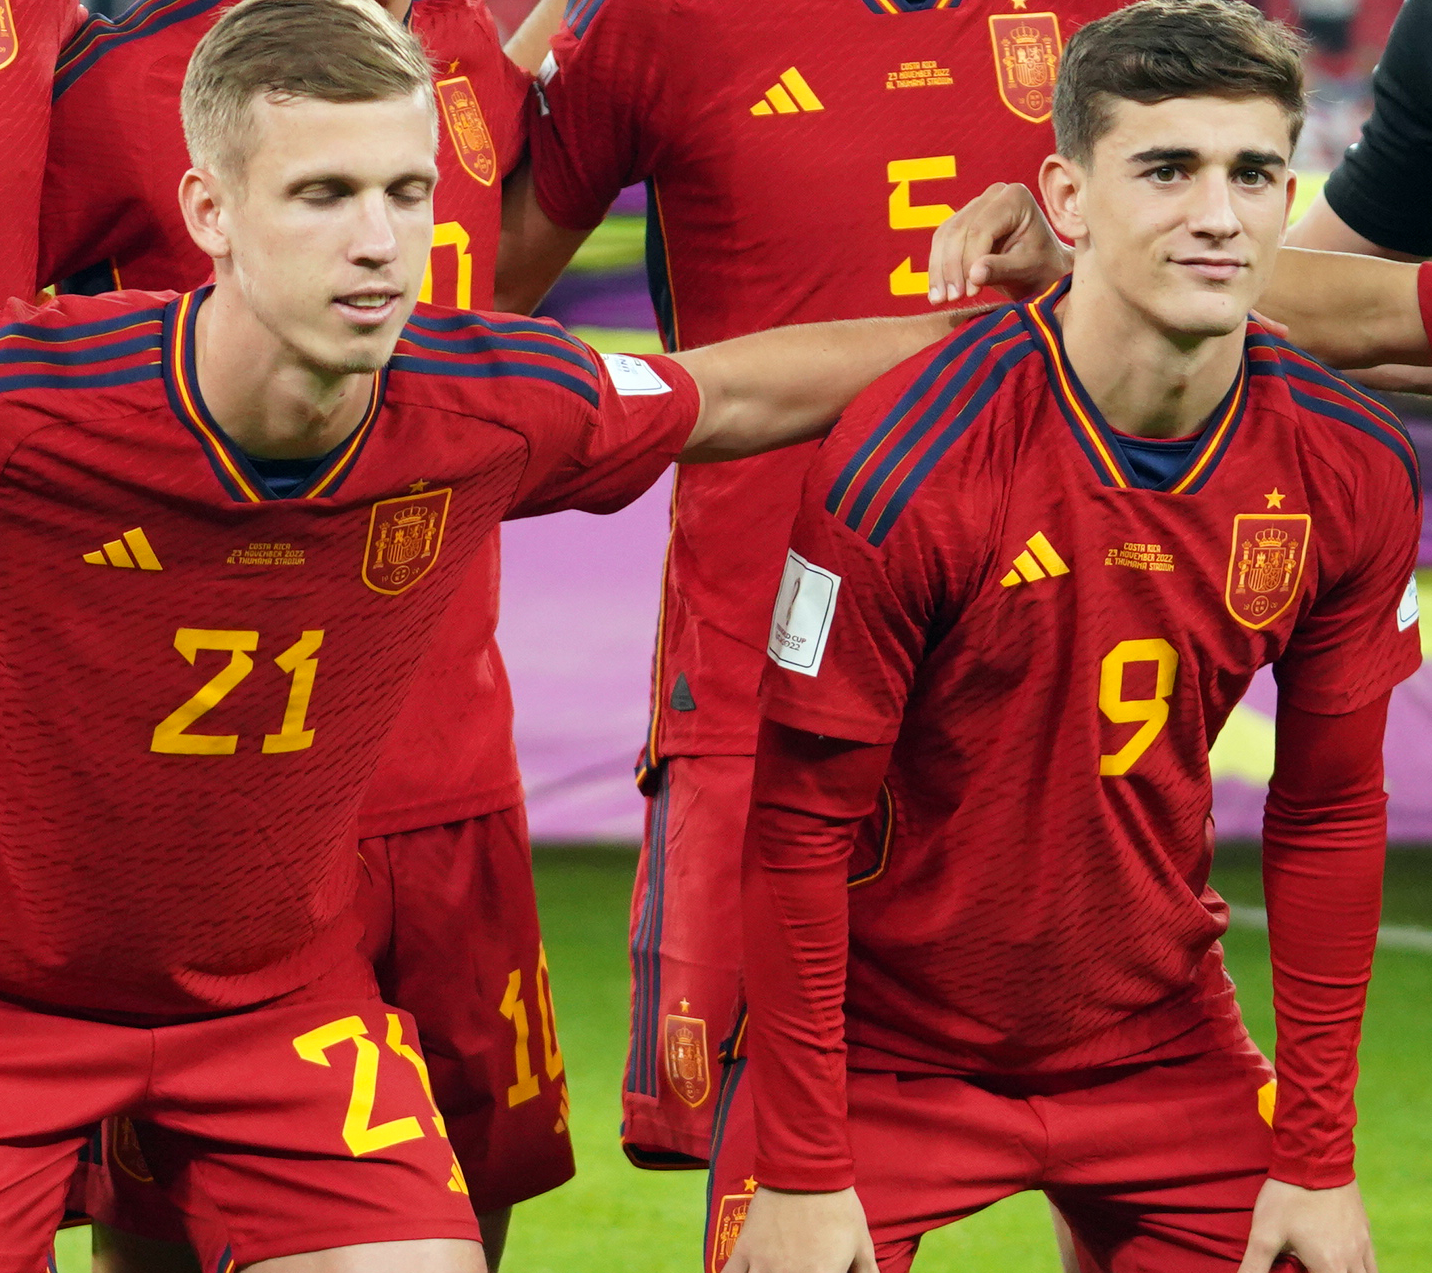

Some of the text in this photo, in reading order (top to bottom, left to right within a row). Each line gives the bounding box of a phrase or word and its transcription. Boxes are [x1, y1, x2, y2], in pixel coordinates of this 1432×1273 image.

[887, 155, 957, 296] 5
[150, 628, 325, 755] 21
[1098, 637, 1178, 777] 9
